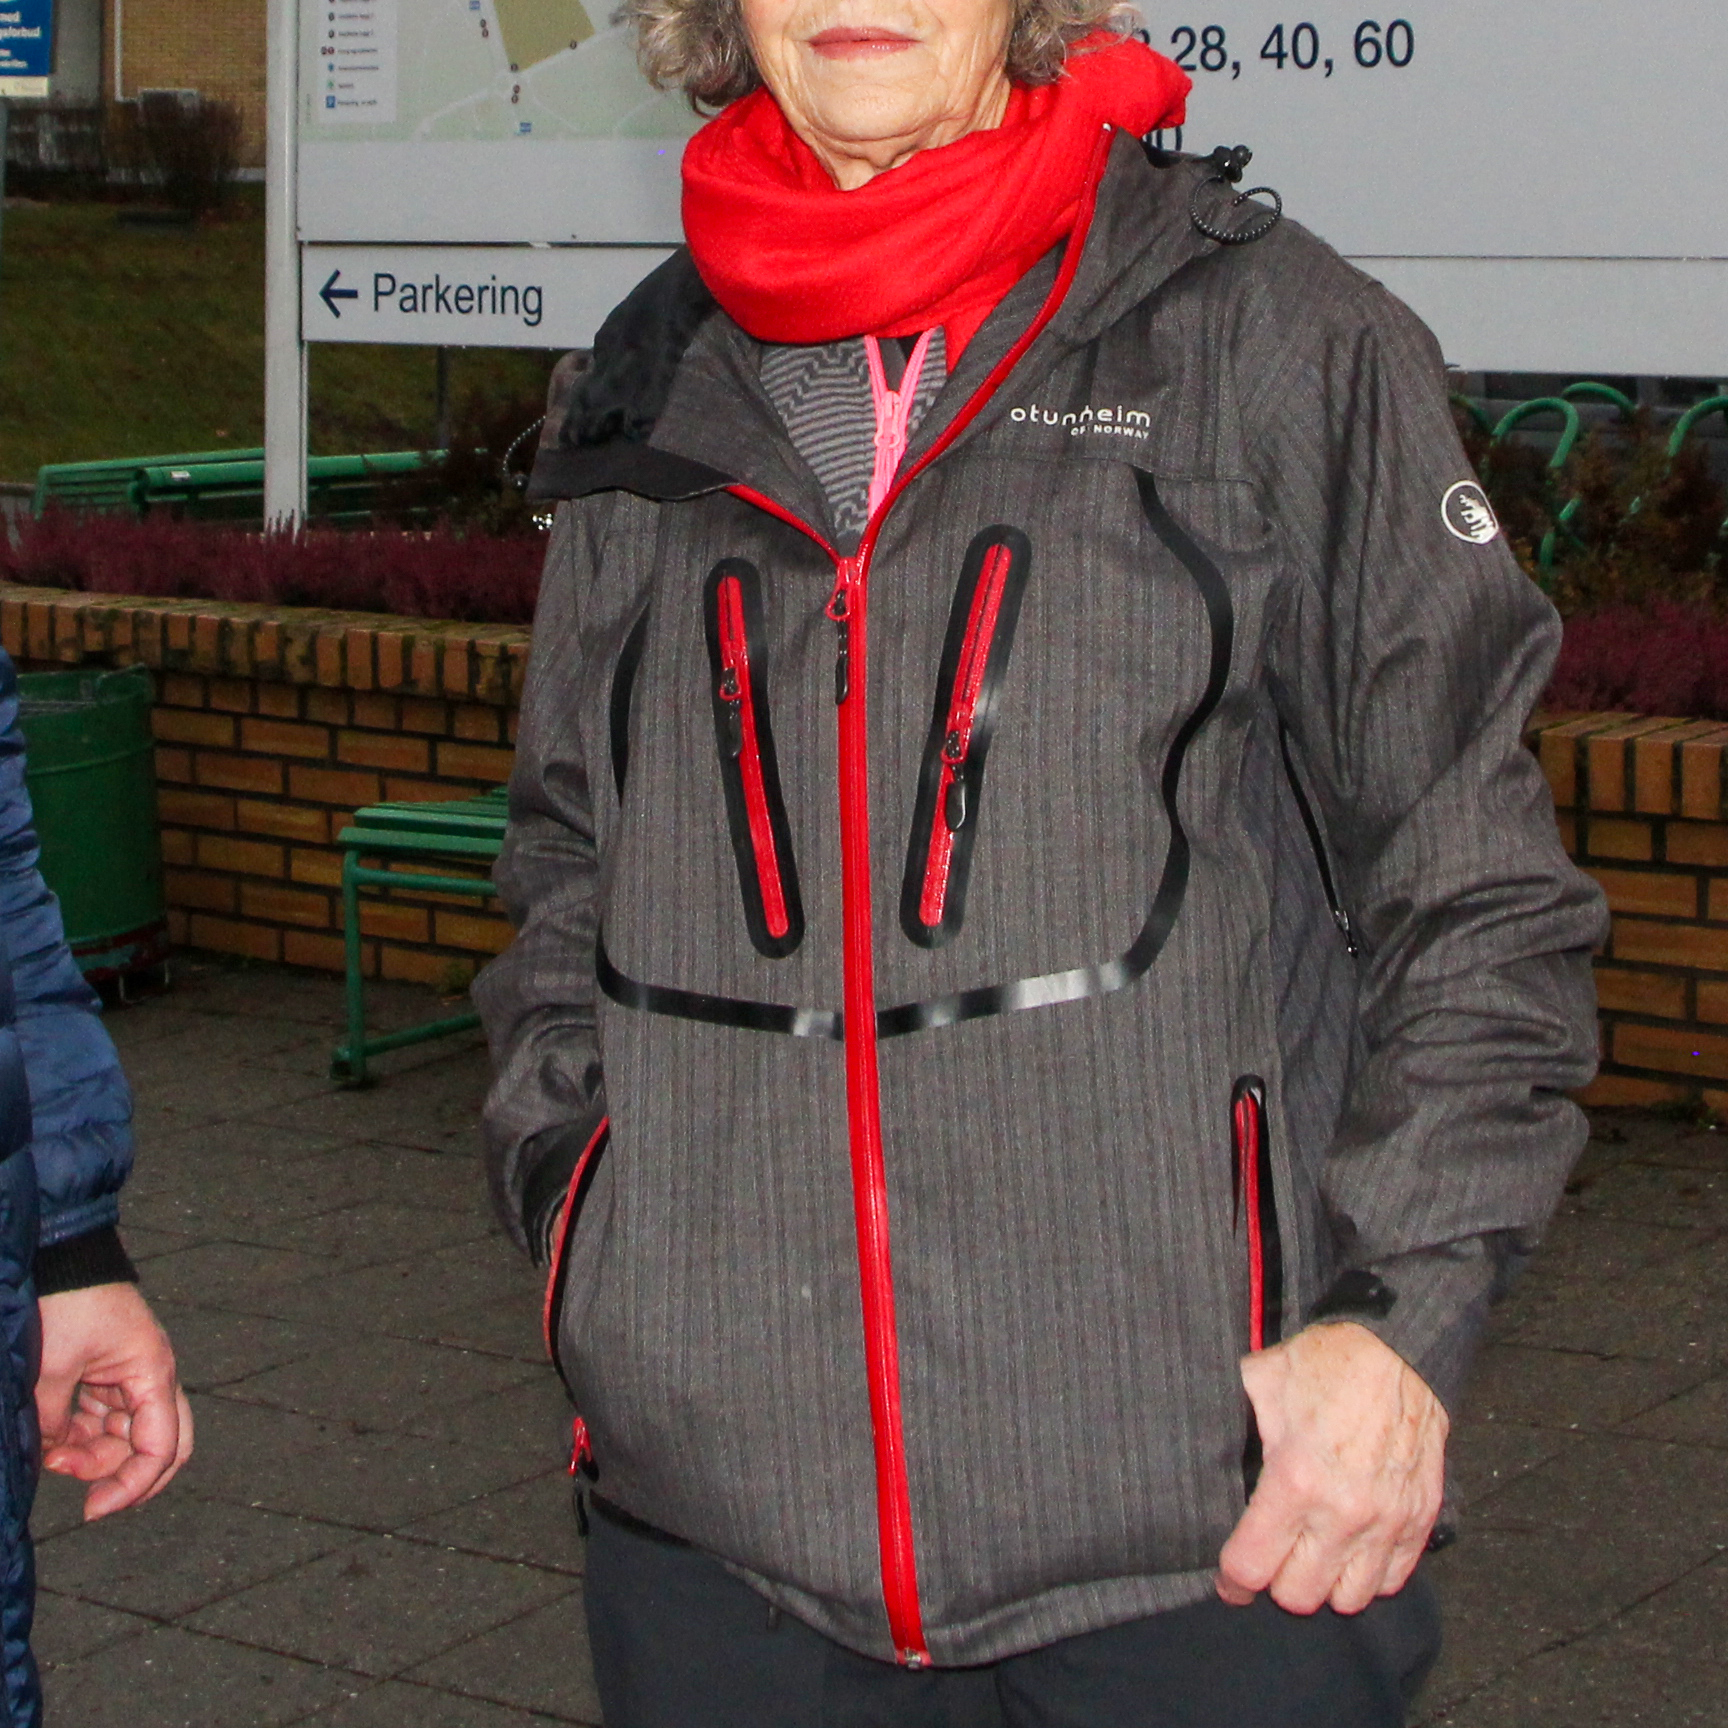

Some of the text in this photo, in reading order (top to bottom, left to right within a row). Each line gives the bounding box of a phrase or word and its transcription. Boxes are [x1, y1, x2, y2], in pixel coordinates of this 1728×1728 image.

[1171, 18, 1415, 80] 28, 40, 60
[373, 272, 543, 328] Parkering
[1071, 424, 1149, 439] OF NORWAY
